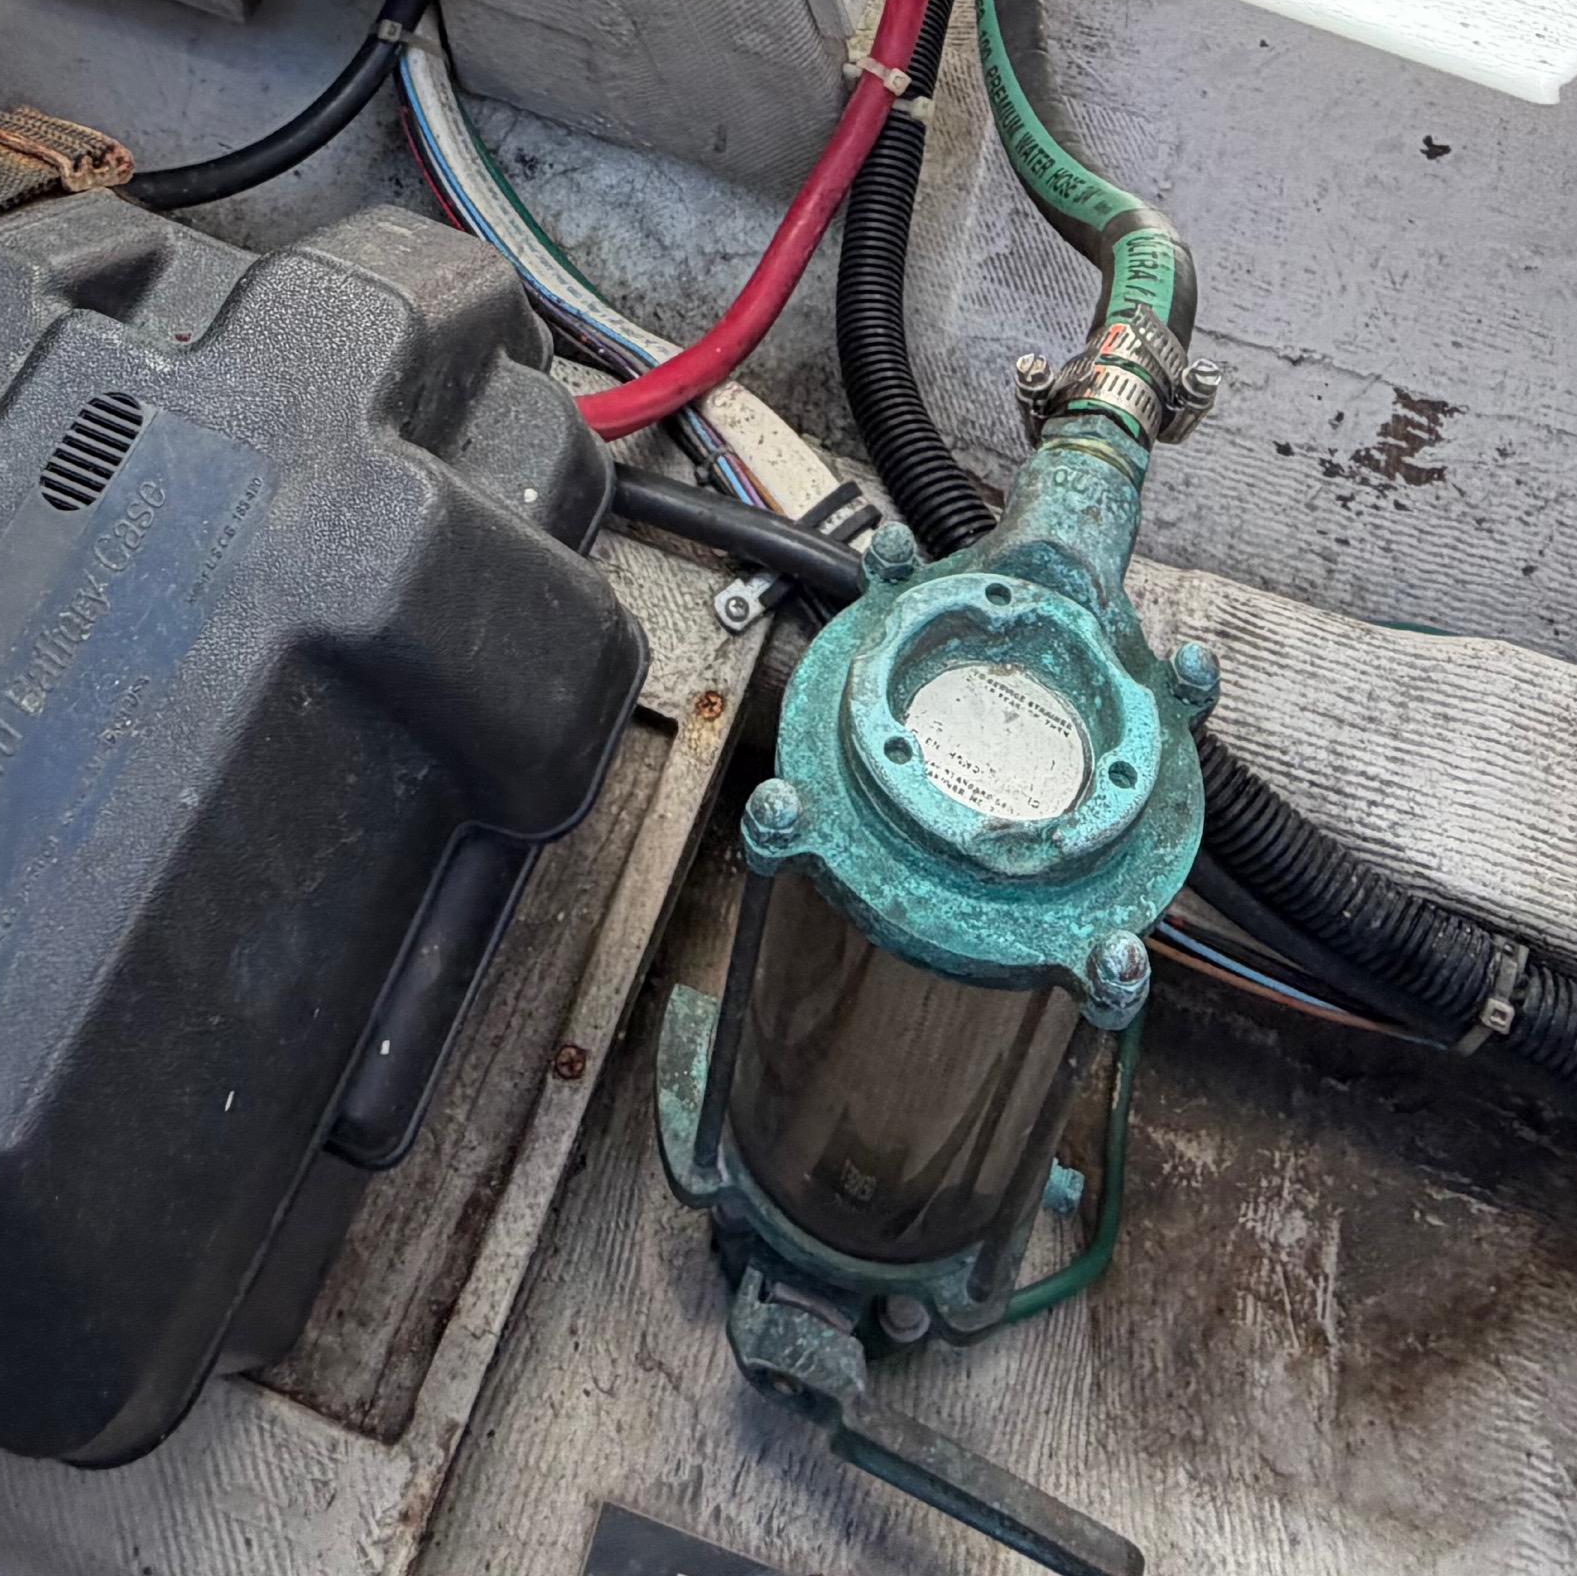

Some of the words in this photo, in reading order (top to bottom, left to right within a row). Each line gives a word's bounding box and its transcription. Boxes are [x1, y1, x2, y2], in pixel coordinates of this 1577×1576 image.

[987, 64, 1025, 141] PREMIUM
[1015, 131, 1056, 178] WATER
[93, 479, 167, 573] Case
